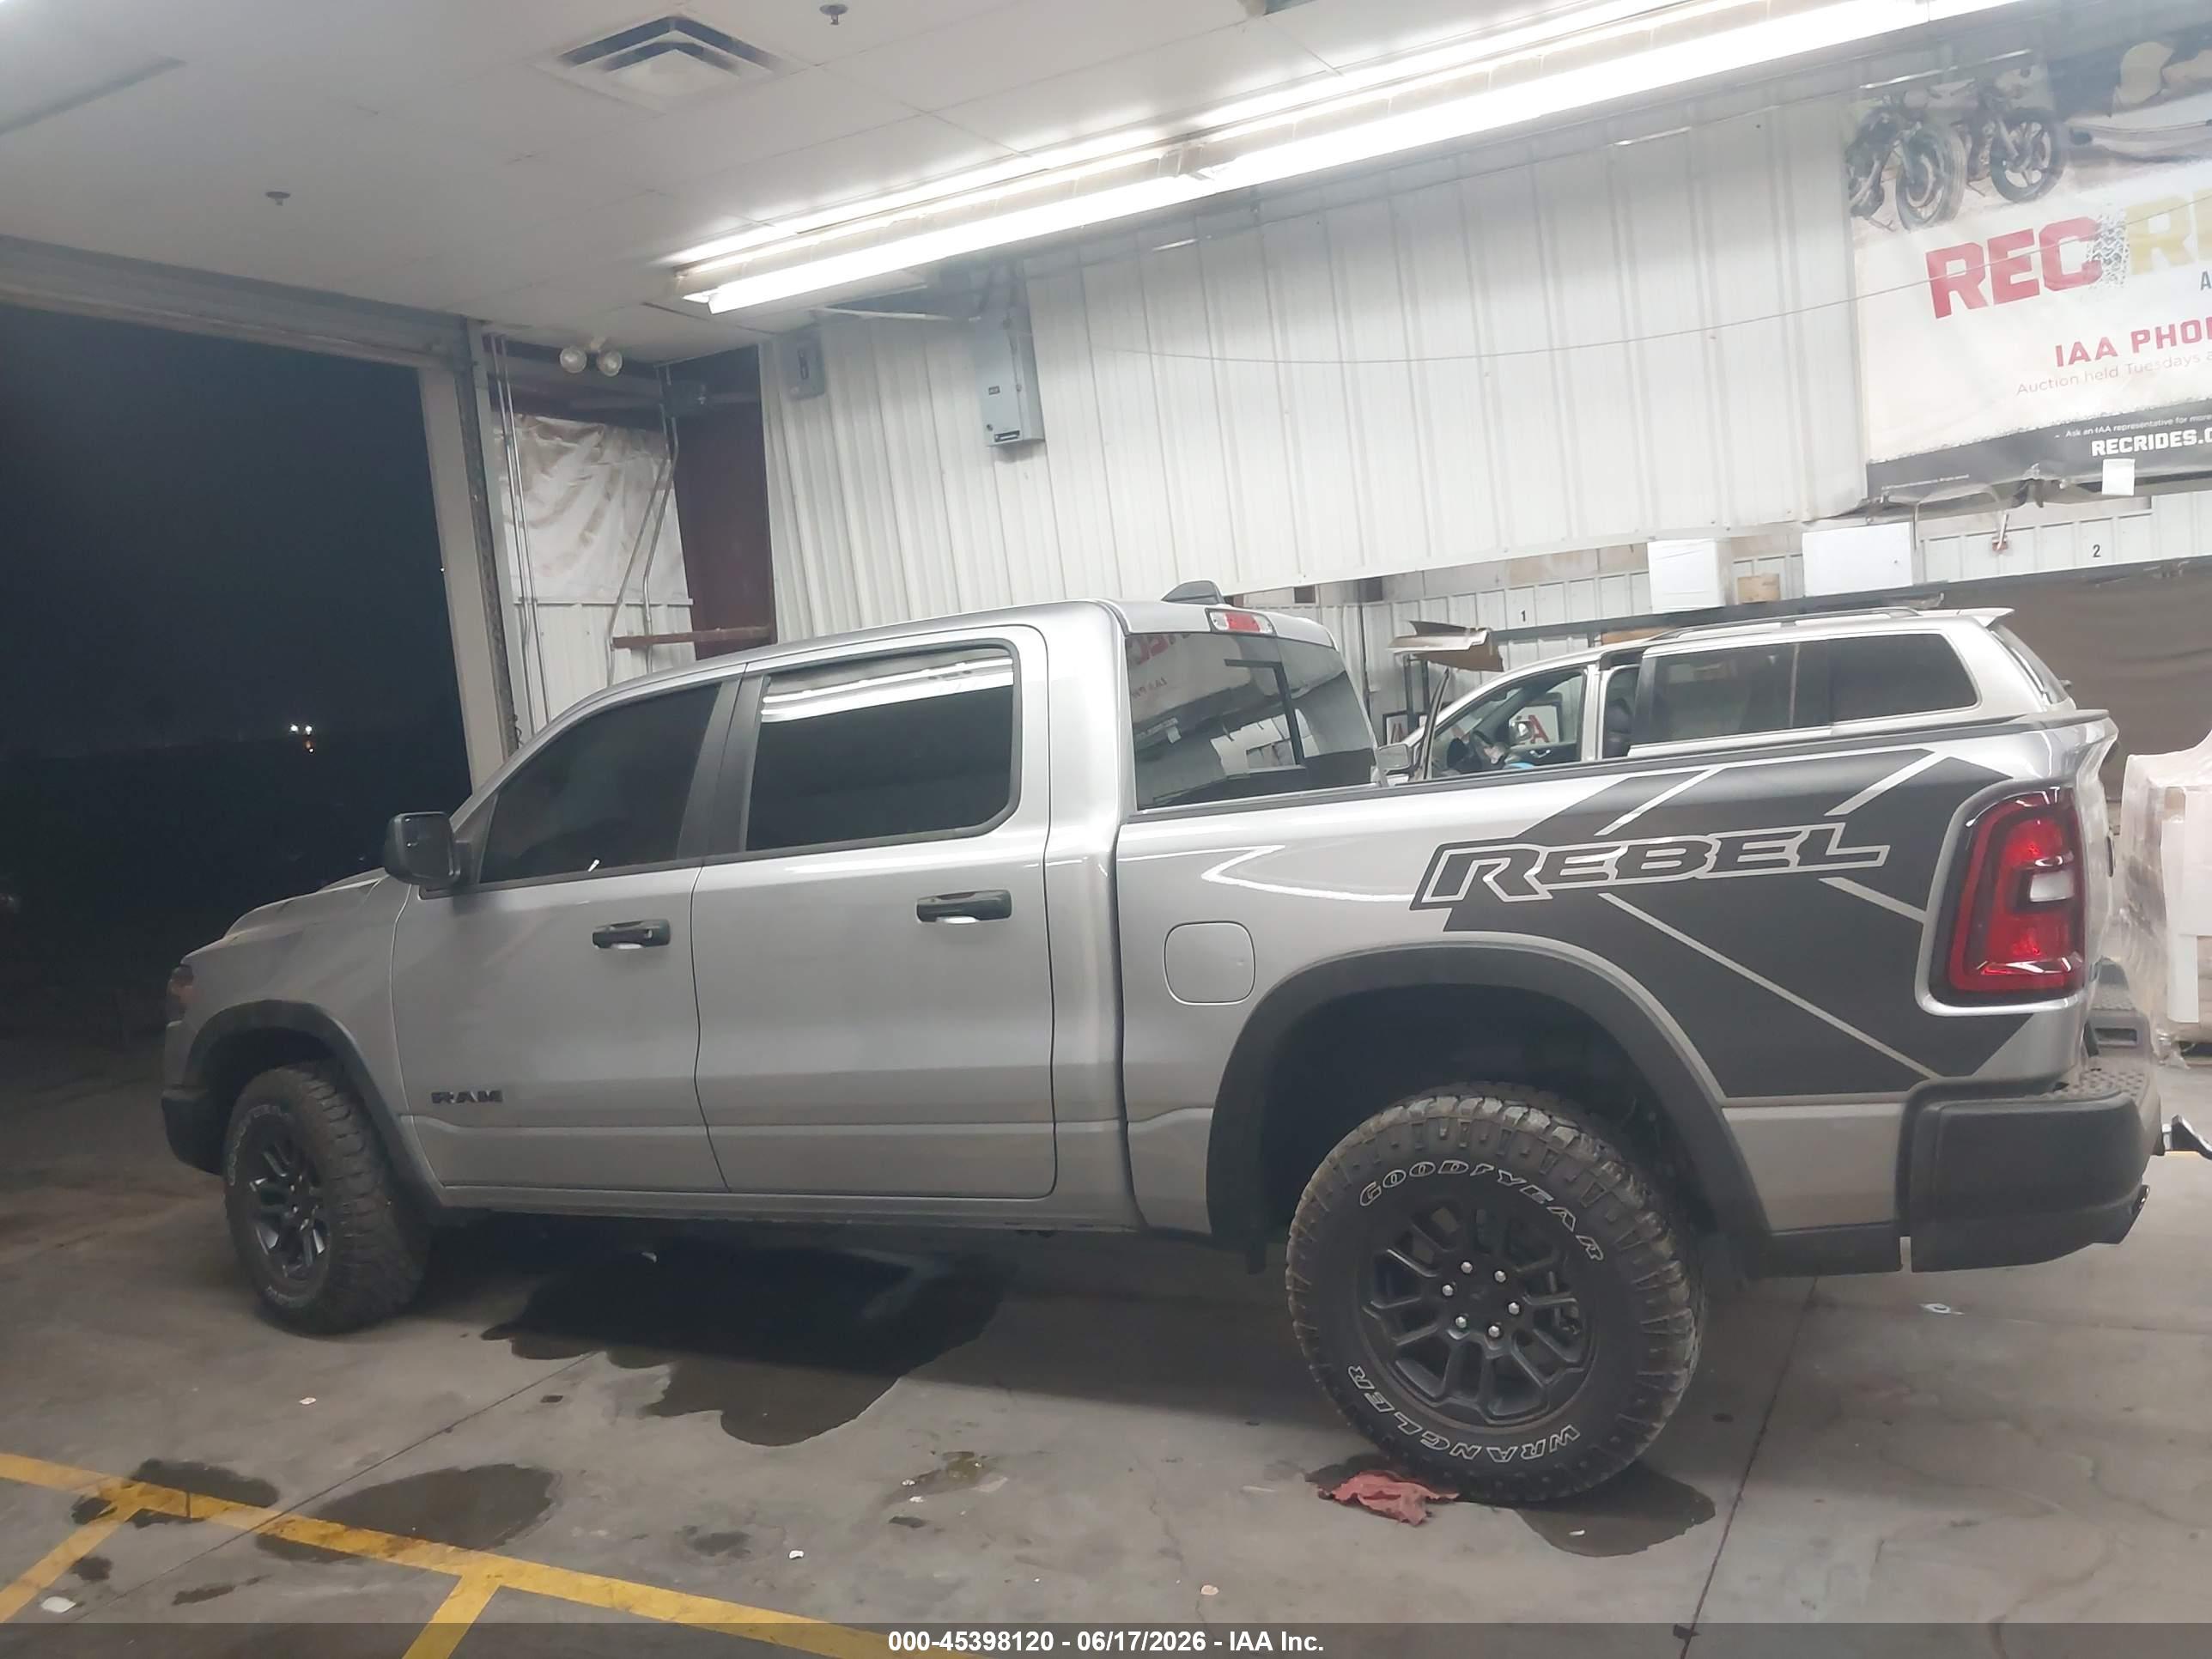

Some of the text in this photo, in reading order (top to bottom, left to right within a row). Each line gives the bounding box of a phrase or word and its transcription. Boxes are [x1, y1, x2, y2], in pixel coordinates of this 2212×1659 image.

[1925, 216, 2104, 319] REC
[2056, 337, 2118, 368] IAA
[2017, 374, 2079, 396] Auction
[2084, 365, 2119, 383] held
[2125, 353, 2200, 375] Tuesdays
[2065, 429, 2081, 438] Ask
[2113, 418, 2174, 432] representative
[2175, 416, 2188, 424] for
[2093, 544, 2101, 558] 2
[1520, 609, 1526, 623] 1
[1414, 822, 1891, 907] REBEL
[431, 1090, 504, 1104] RAM
[1359, 1159, 1604, 1262] GOODYEAR
[1346, 1364, 1581, 1463] WRANGLER
